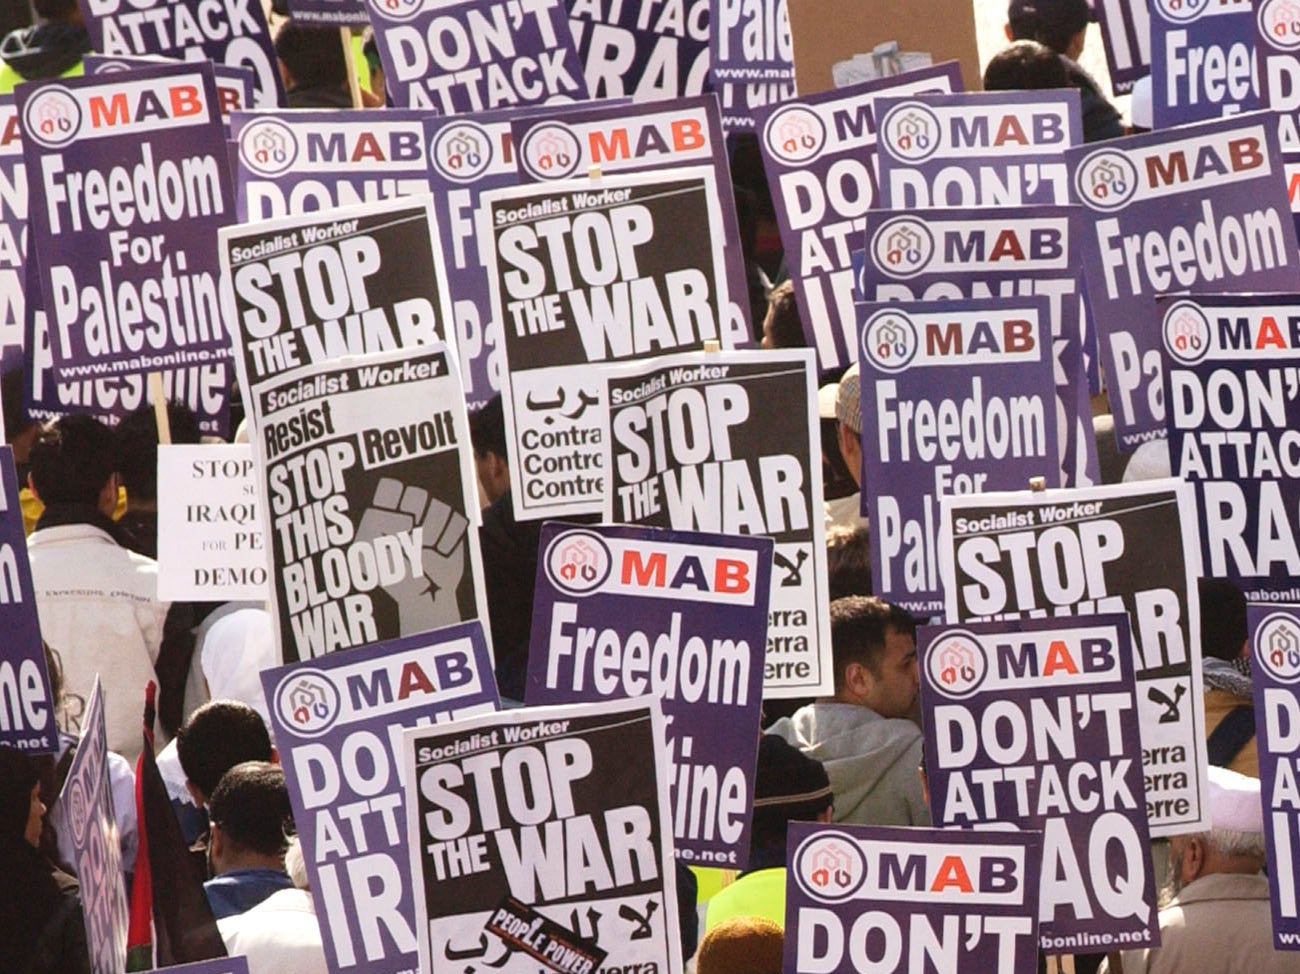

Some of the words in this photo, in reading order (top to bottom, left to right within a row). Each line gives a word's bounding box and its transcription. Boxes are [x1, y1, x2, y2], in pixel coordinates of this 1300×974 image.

[89, 85, 203, 128] MAB
[950, 113, 1064, 147] MAB
[307, 131, 422, 162] MAB
[589, 118, 705, 163] MAB
[41, 142, 223, 233] Freedom
[496, 194, 568, 225] Socialist
[572, 187, 632, 211] Worker
[109, 230, 165, 266] For
[231, 234, 298, 263] Socialist
[302, 219, 359, 248] Worker
[499, 203, 654, 300] STOP
[944, 228, 1063, 263] MAB
[1096, 200, 1287, 300] Freedom
[235, 235, 382, 338] STOP
[509, 294, 565, 336] THE
[563, 268, 719, 360] WAR
[925, 319, 1035, 356] MAB
[266, 375, 349, 412] Socialist
[358, 359, 441, 391] Worker
[611, 372, 665, 404] Socialist
[669, 364, 729, 385] Worker
[264, 401, 335, 460] Resist
[365, 409, 458, 466] Revolt
[612, 383, 749, 484] STOP
[875, 377, 1046, 462] Freedom
[269, 442, 357, 517] STOP
[619, 476, 662, 522] THE
[275, 496, 354, 566] THIS
[955, 512, 1034, 534] Socialist
[1040, 501, 1103, 524] Worker
[194, 568, 268, 588] DEMO
[283, 527, 425, 611] BLOODY
[957, 519, 1124, 616] STOP
[347, 650, 473, 711] MAB
[418, 731, 499, 762] Socialist
[503, 719, 569, 744] Worker
[934, 692, 1132, 769] DON'T
[420, 737, 593, 840] STOP
[943, 758, 1137, 822] ATTACK
[428, 834, 490, 881] THE
[495, 804, 659, 905] WAR
[879, 854, 1019, 894] MAB
[491, 909, 545, 951] PEOPLE
